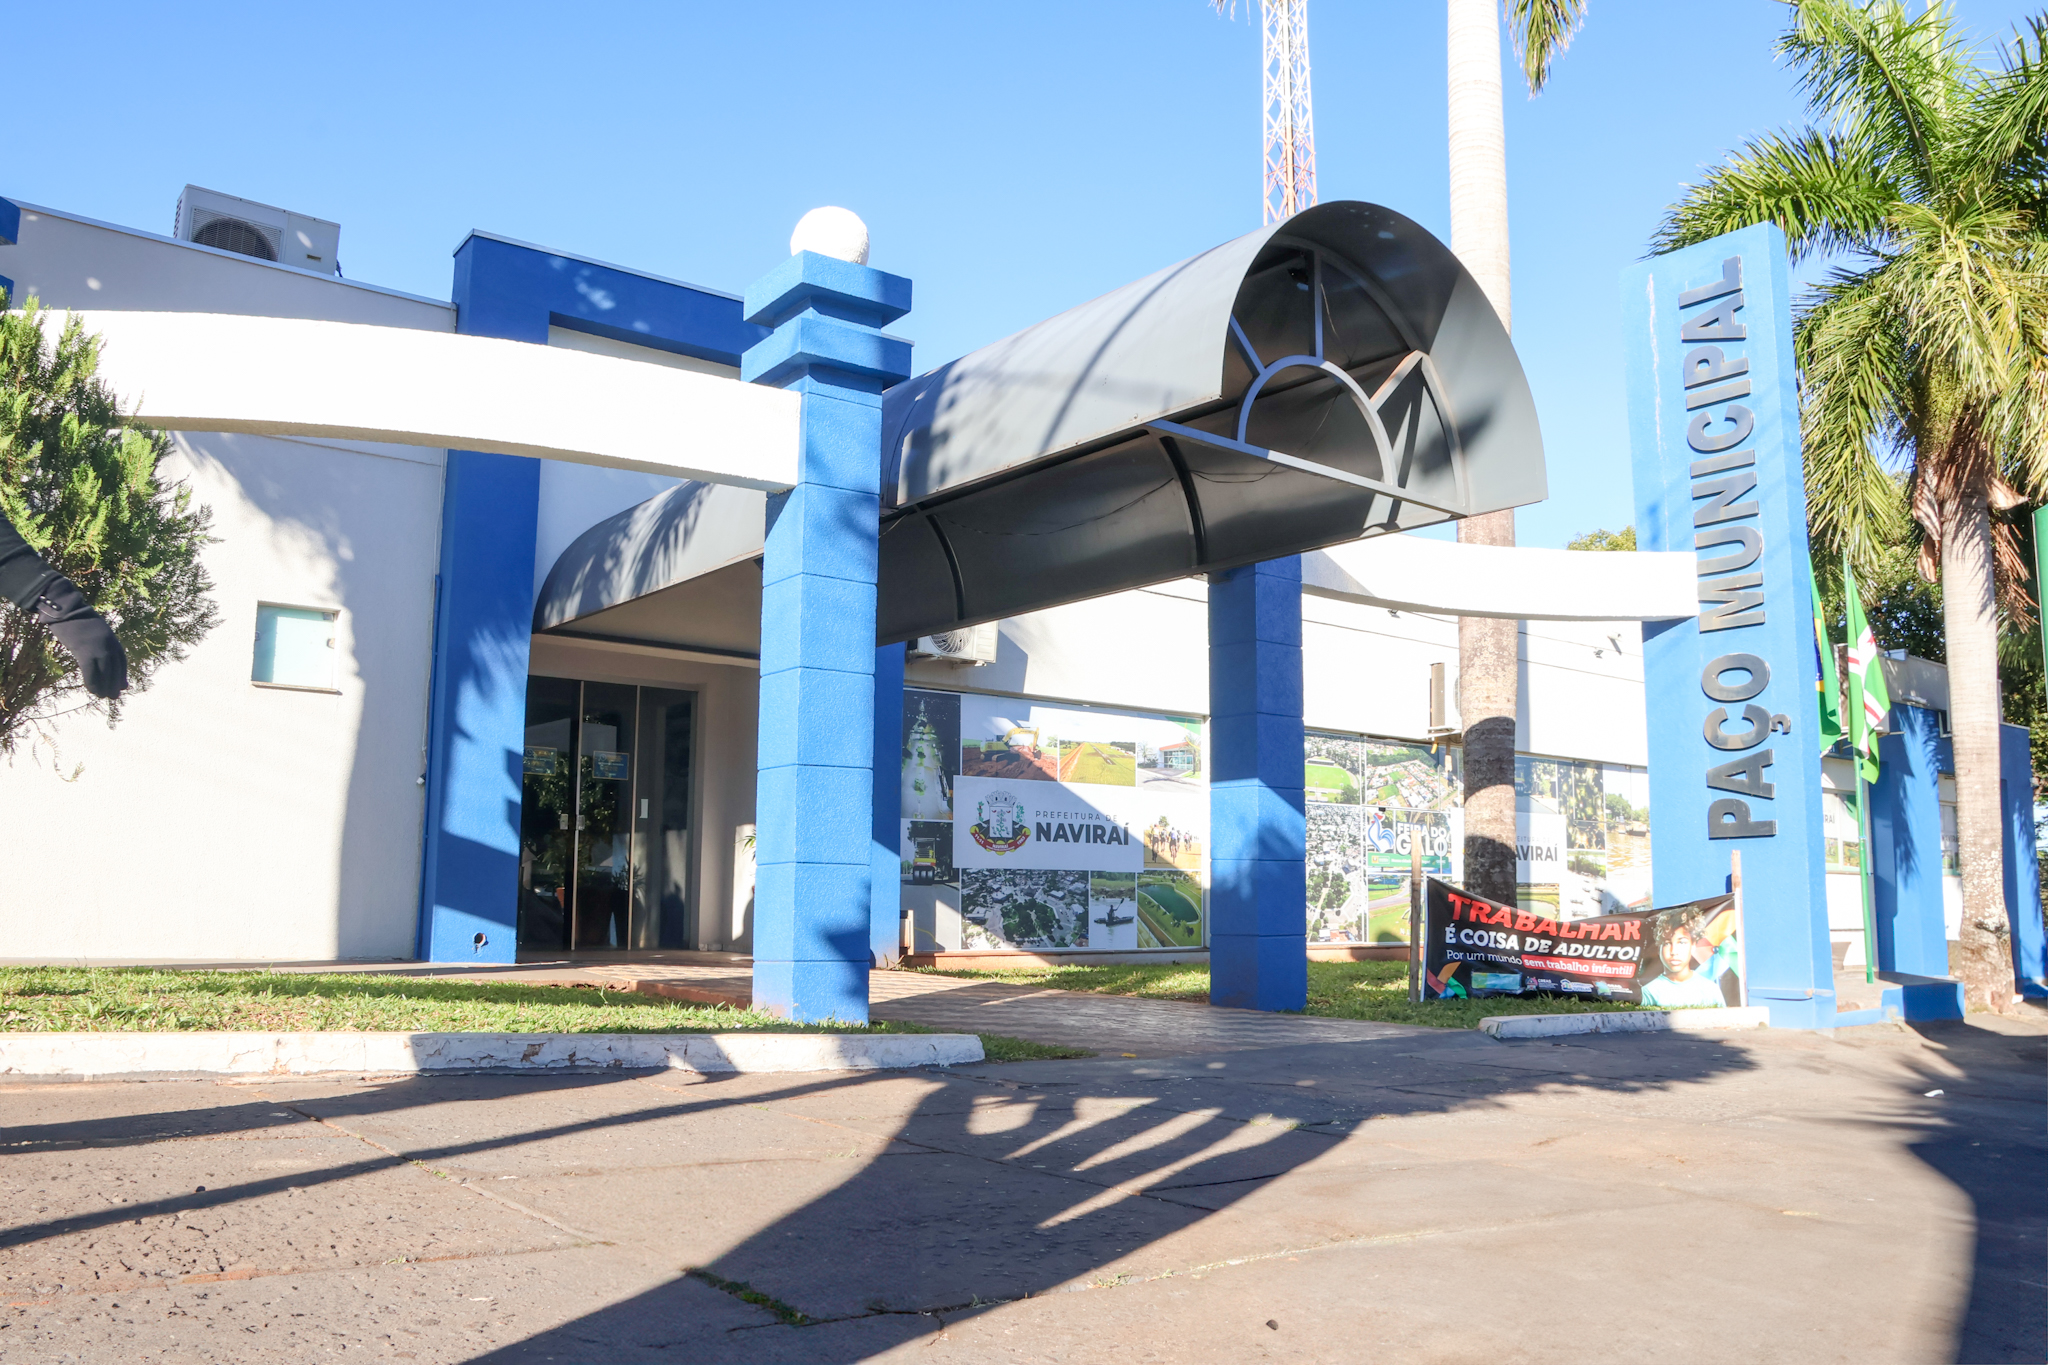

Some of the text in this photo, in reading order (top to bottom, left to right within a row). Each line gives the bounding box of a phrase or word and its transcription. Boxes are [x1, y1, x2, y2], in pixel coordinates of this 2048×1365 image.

[1679, 255, 1791, 840] PAÇO MUNICIPAL
[1035, 810, 1101, 821] PREFEITURA
[1036, 822, 1129, 846] NAVIRAÍ
[1431, 826, 1447, 838] DO
[1448, 893, 1641, 941] TRABALHAR
[1445, 923, 1641, 961] É COISA DE ADULTO!
[1446, 949, 1634, 976] Por um mundo sem trabalho infantil!
